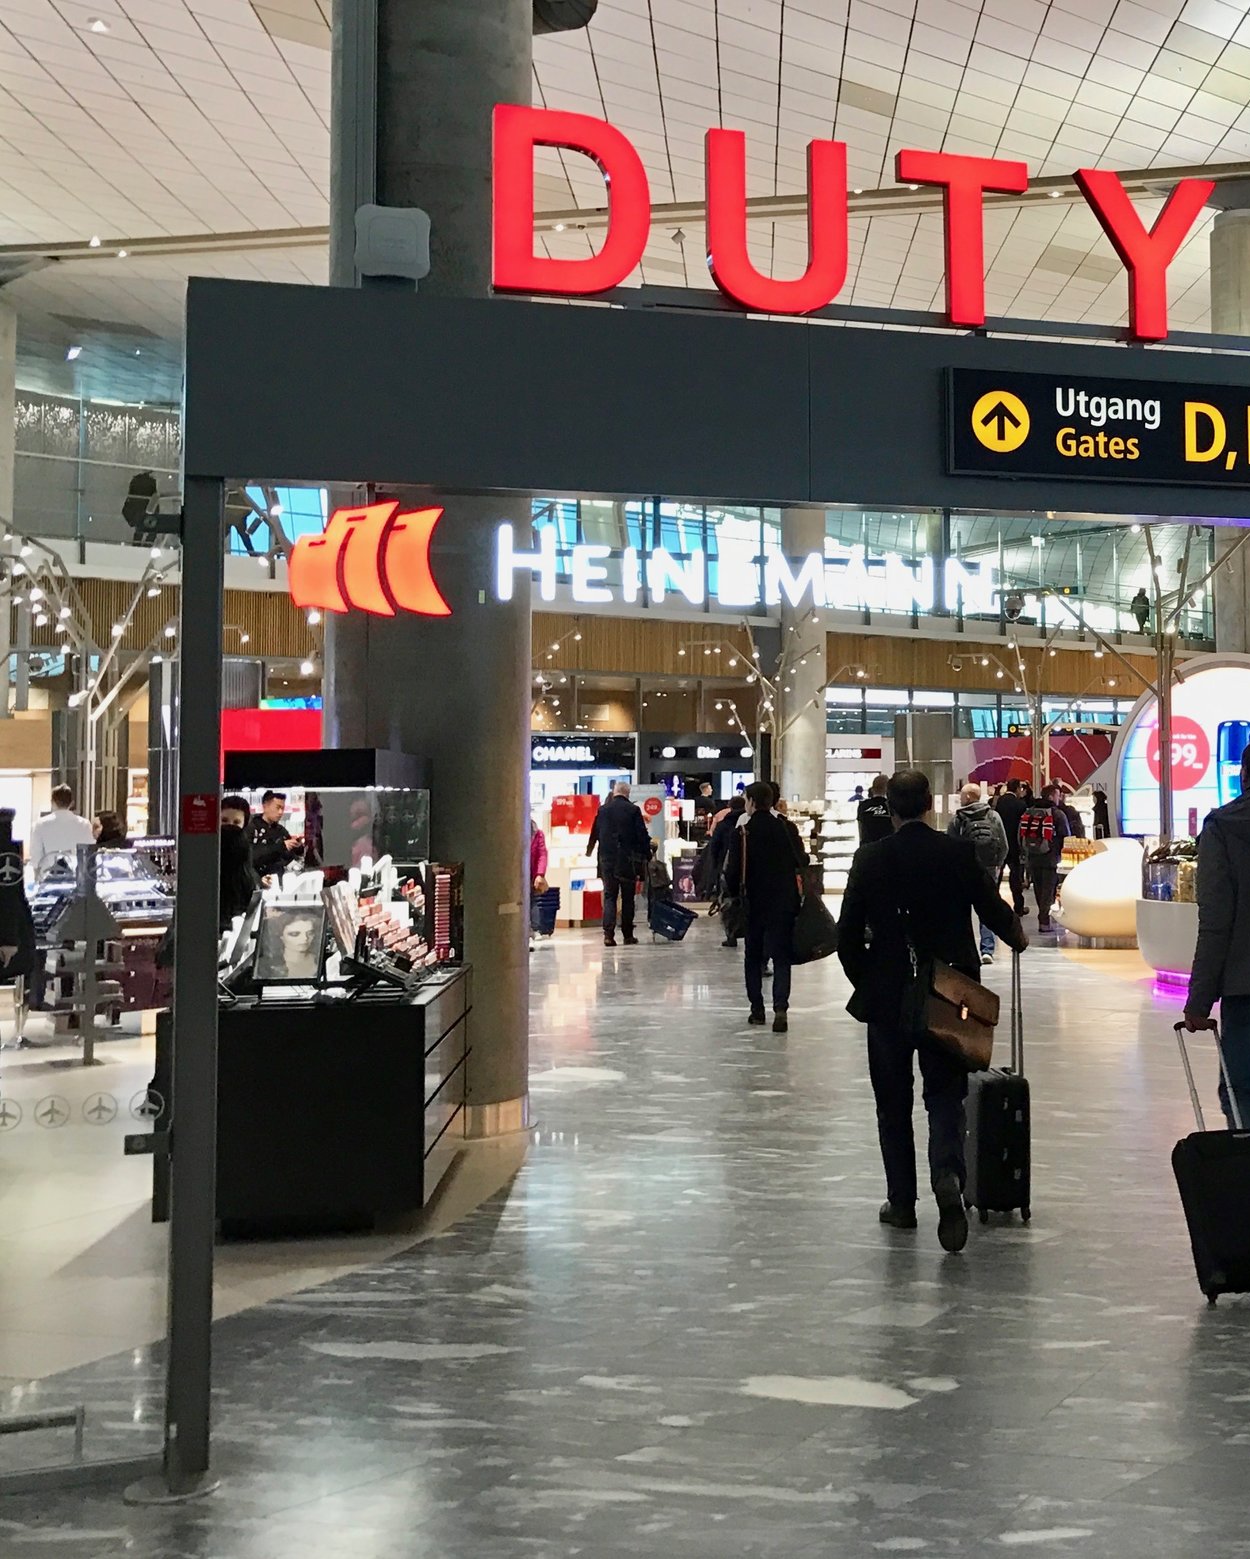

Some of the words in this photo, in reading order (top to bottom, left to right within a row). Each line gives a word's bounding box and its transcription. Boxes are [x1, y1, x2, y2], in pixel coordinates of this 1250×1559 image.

[492, 104, 1214, 343] DUTY
[1055, 387, 1161, 430] Utgang
[1056, 428, 1140, 460] Gates
[532, 746, 595, 762] CHANEL
[697, 746, 721, 759] Dior
[1153, 743, 1197, 767] 99
